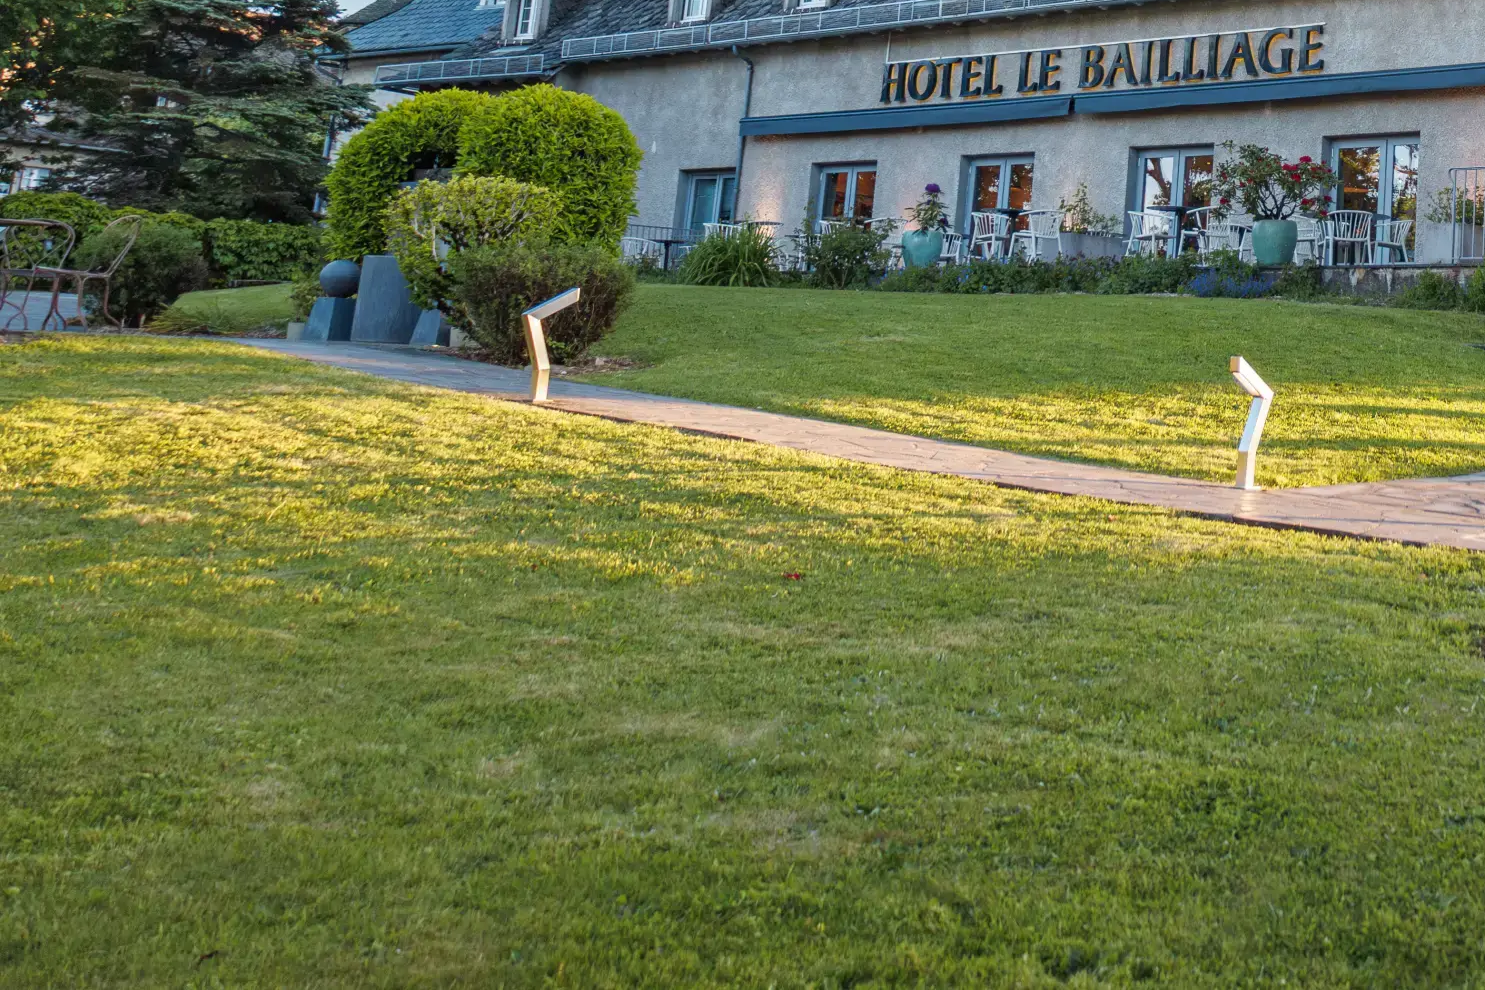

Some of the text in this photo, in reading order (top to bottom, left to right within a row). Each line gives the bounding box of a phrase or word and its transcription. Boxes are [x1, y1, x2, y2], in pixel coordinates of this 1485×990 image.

[880, 25, 1326, 104] HOTEL LE BAILLIAGE
